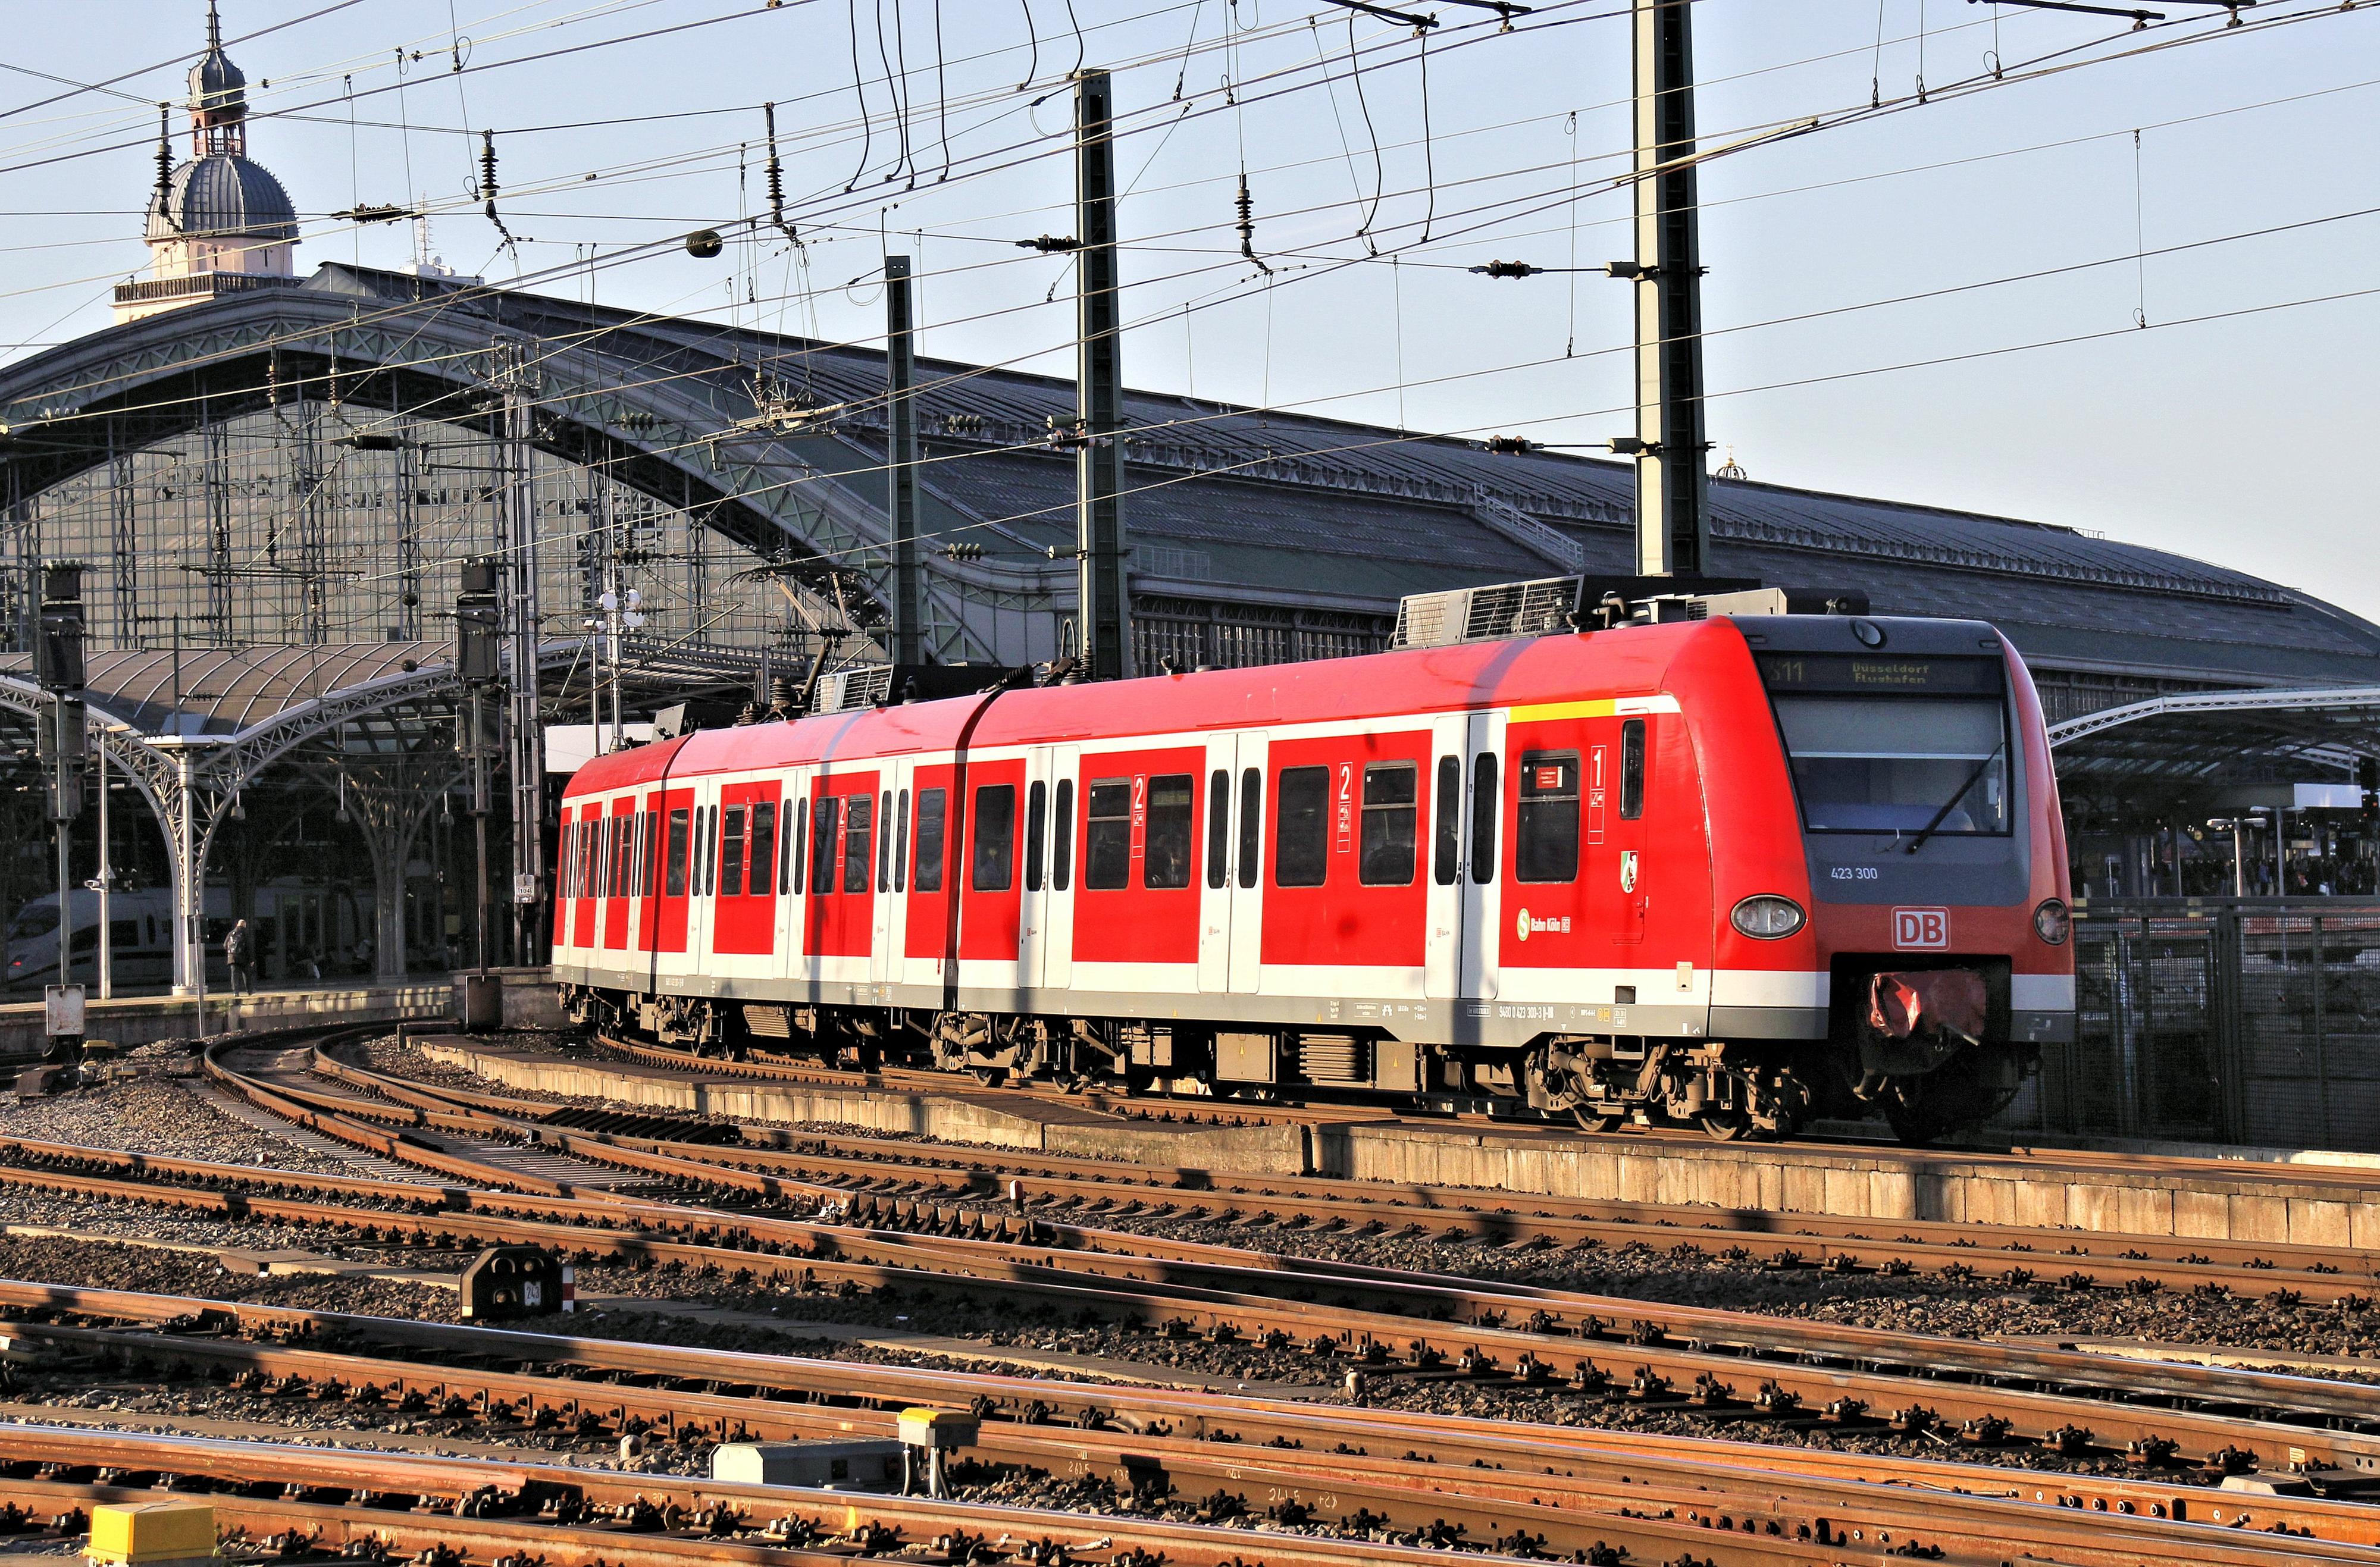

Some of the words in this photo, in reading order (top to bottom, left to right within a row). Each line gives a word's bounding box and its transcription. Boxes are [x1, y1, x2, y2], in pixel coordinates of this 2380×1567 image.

[1855, 672, 1927, 684] Flughafen
[1593, 749, 1602, 787] 1
[1135, 777, 1143, 810] 2
[1341, 765, 1350, 800] 2
[746, 804, 751, 831] 2
[840, 797, 845, 825] 2
[1831, 868, 1852, 879] 423
[1855, 868, 1878, 879] 300
[1518, 911, 1529, 939] S
[1530, 917, 1546, 932] Bahn
[1546, 917, 1561, 932] Köln
[1899, 914, 1943, 944] DB
[1516, 1006, 1526, 1019] 423
[527, 1286, 539, 1299] 243
